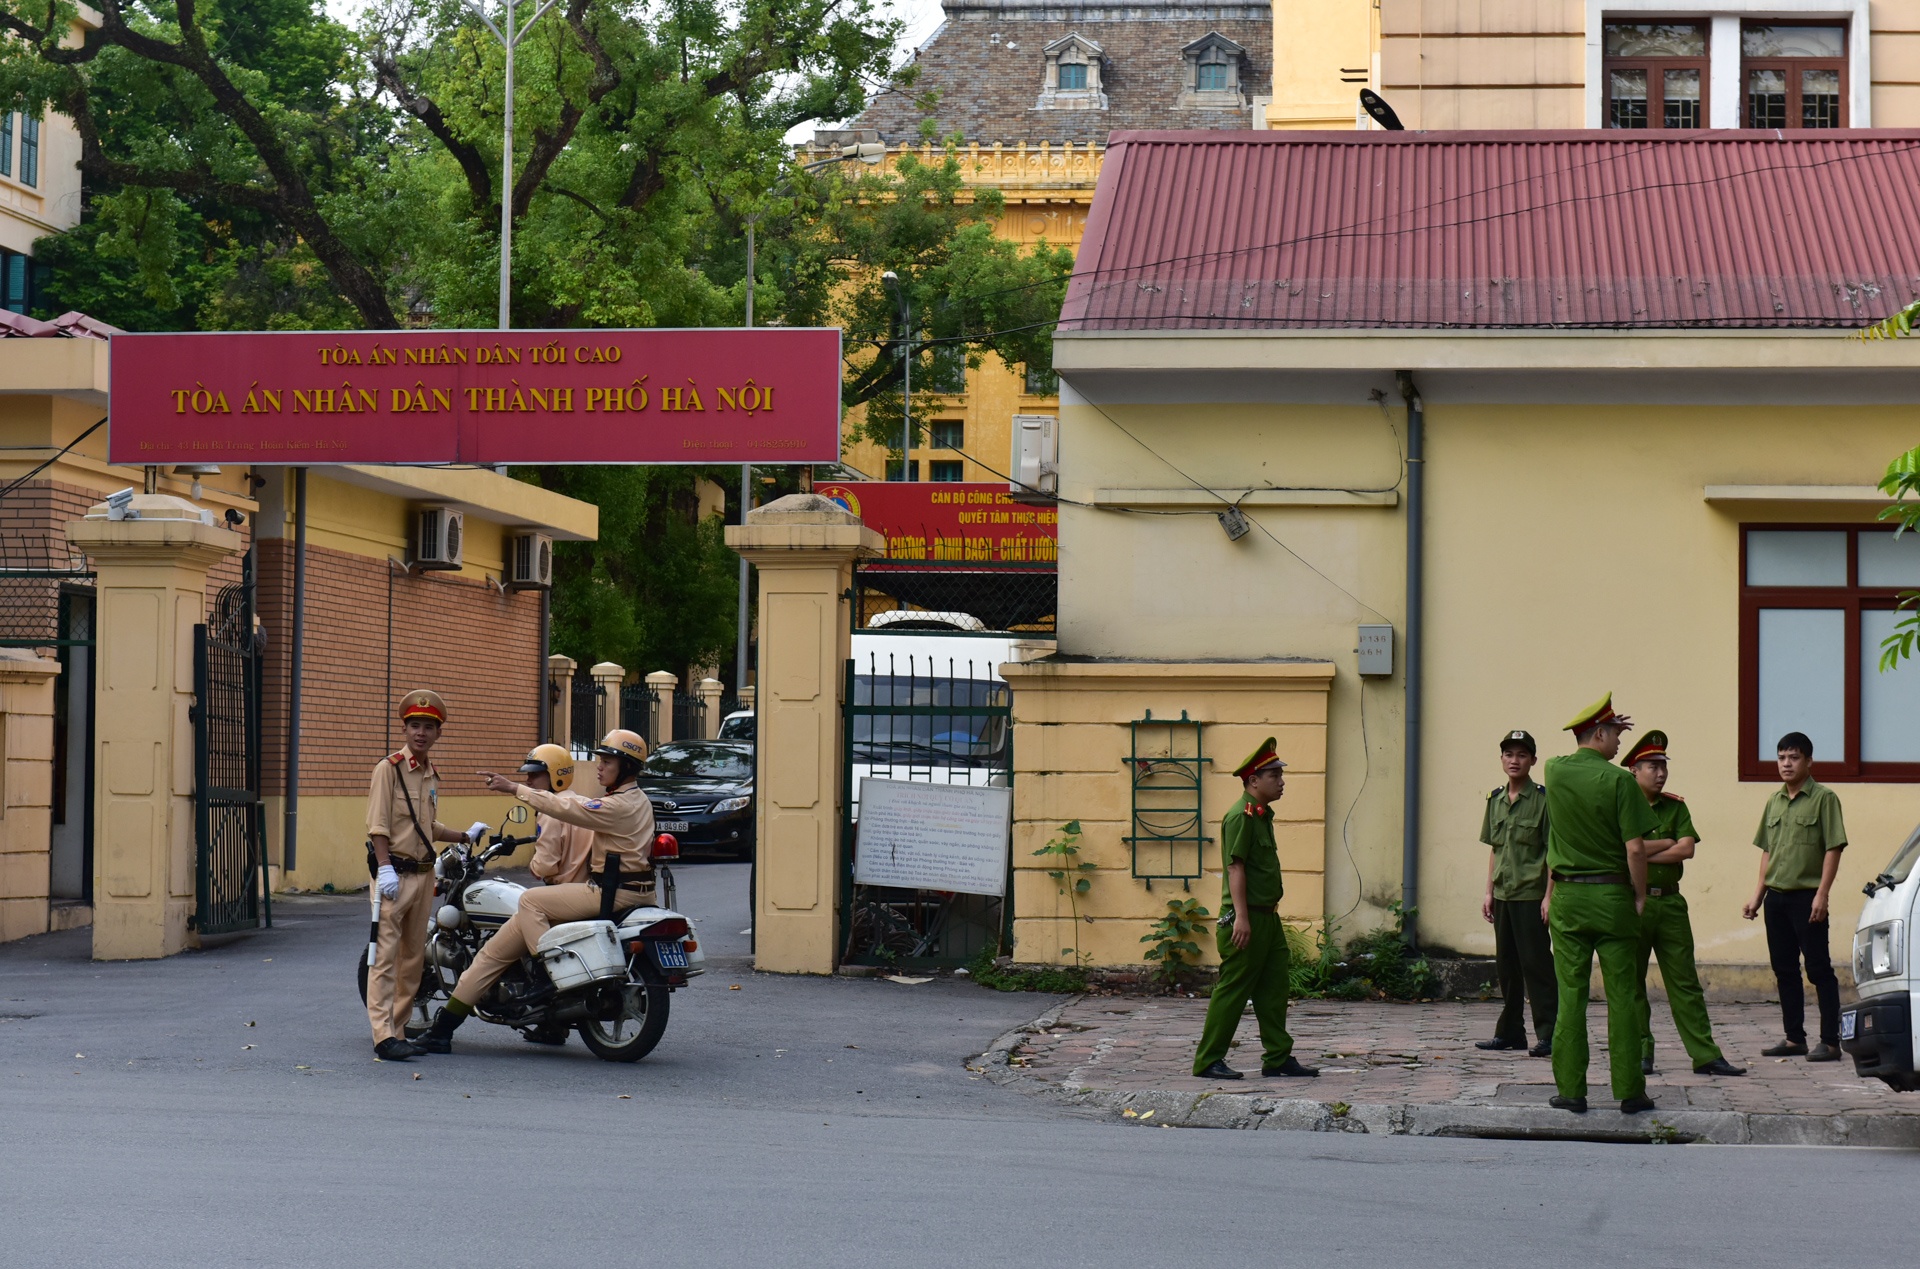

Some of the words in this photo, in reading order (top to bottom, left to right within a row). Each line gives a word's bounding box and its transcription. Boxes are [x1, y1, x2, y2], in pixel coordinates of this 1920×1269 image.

[318, 342, 362, 366] TÒA
[367, 342, 398, 365] ÁN
[404, 344, 469, 365] NHÂN
[475, 343, 521, 364] DÂN
[529, 340, 567, 364] TỐI
[574, 346, 622, 364] CAO
[171, 381, 231, 414] TÒA
[241, 381, 282, 413] ÁN
[292, 381, 378, 413] NHÂN
[391, 380, 452, 412] DÂN
[464, 378, 574, 412] THÀNH
[585, 374, 649, 412] PHỐ
[660, 377, 705, 411] HÀ
[716, 377, 774, 416] NỘI
[192, 440, 208, 450] Hai
[931, 489, 951, 504] CÁN
[953, 489, 966, 506] BỘ
[967, 489, 993, 504] CÔNG
[958, 508, 988, 524] QUYẾT
[990, 509, 1010, 524] TÂM
[1012, 511, 1036, 526] THỰC
[1037, 509, 1058, 526] HIỆN
[934, 537, 963, 561] MINH
[1000, 531, 1028, 561] CHẤT
[622, 741, 642, 753] CSGT
[656, 822, 687, 831] A-849.66
[663, 954, 685, 966] 1189
